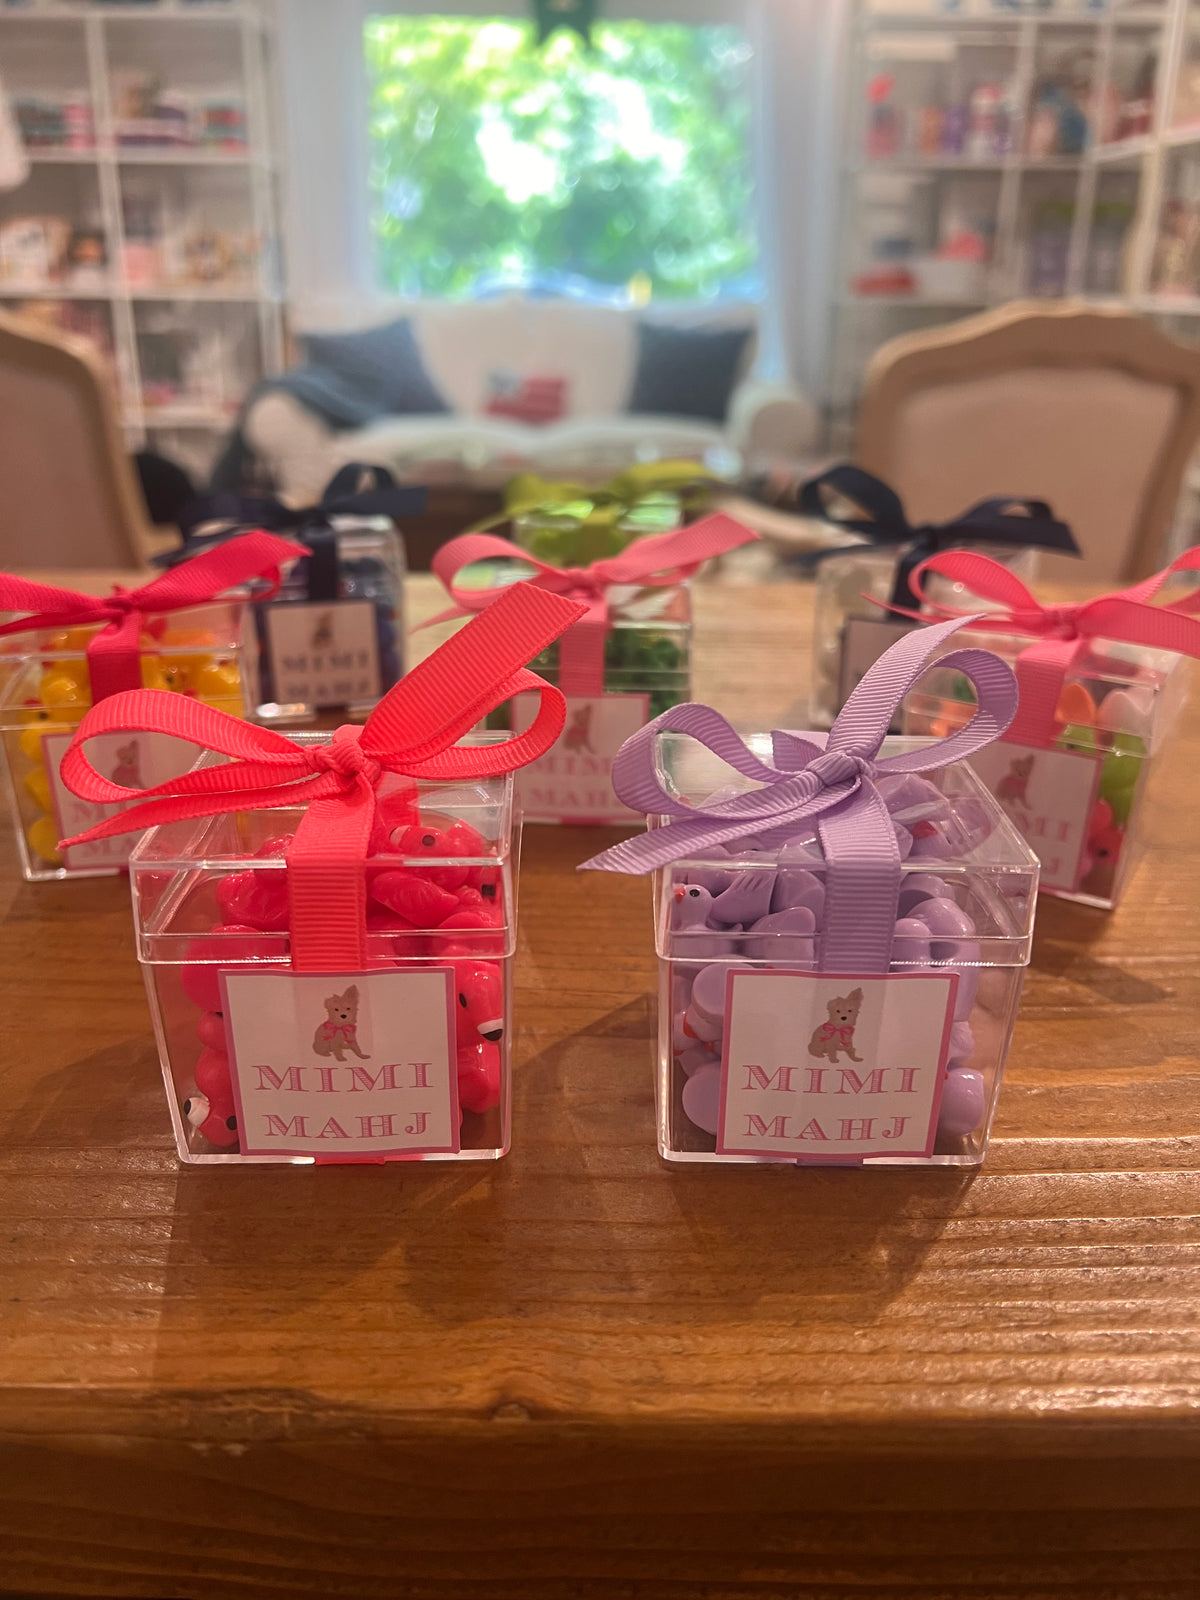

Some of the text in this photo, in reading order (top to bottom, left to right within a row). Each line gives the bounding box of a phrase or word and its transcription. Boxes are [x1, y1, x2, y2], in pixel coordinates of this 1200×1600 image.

[252, 1063, 434, 1093] MIMI
[740, 1064, 921, 1095] MIMI
[262, 1112, 432, 1139] MAHJ
[742, 1114, 912, 1141] MAHJ
